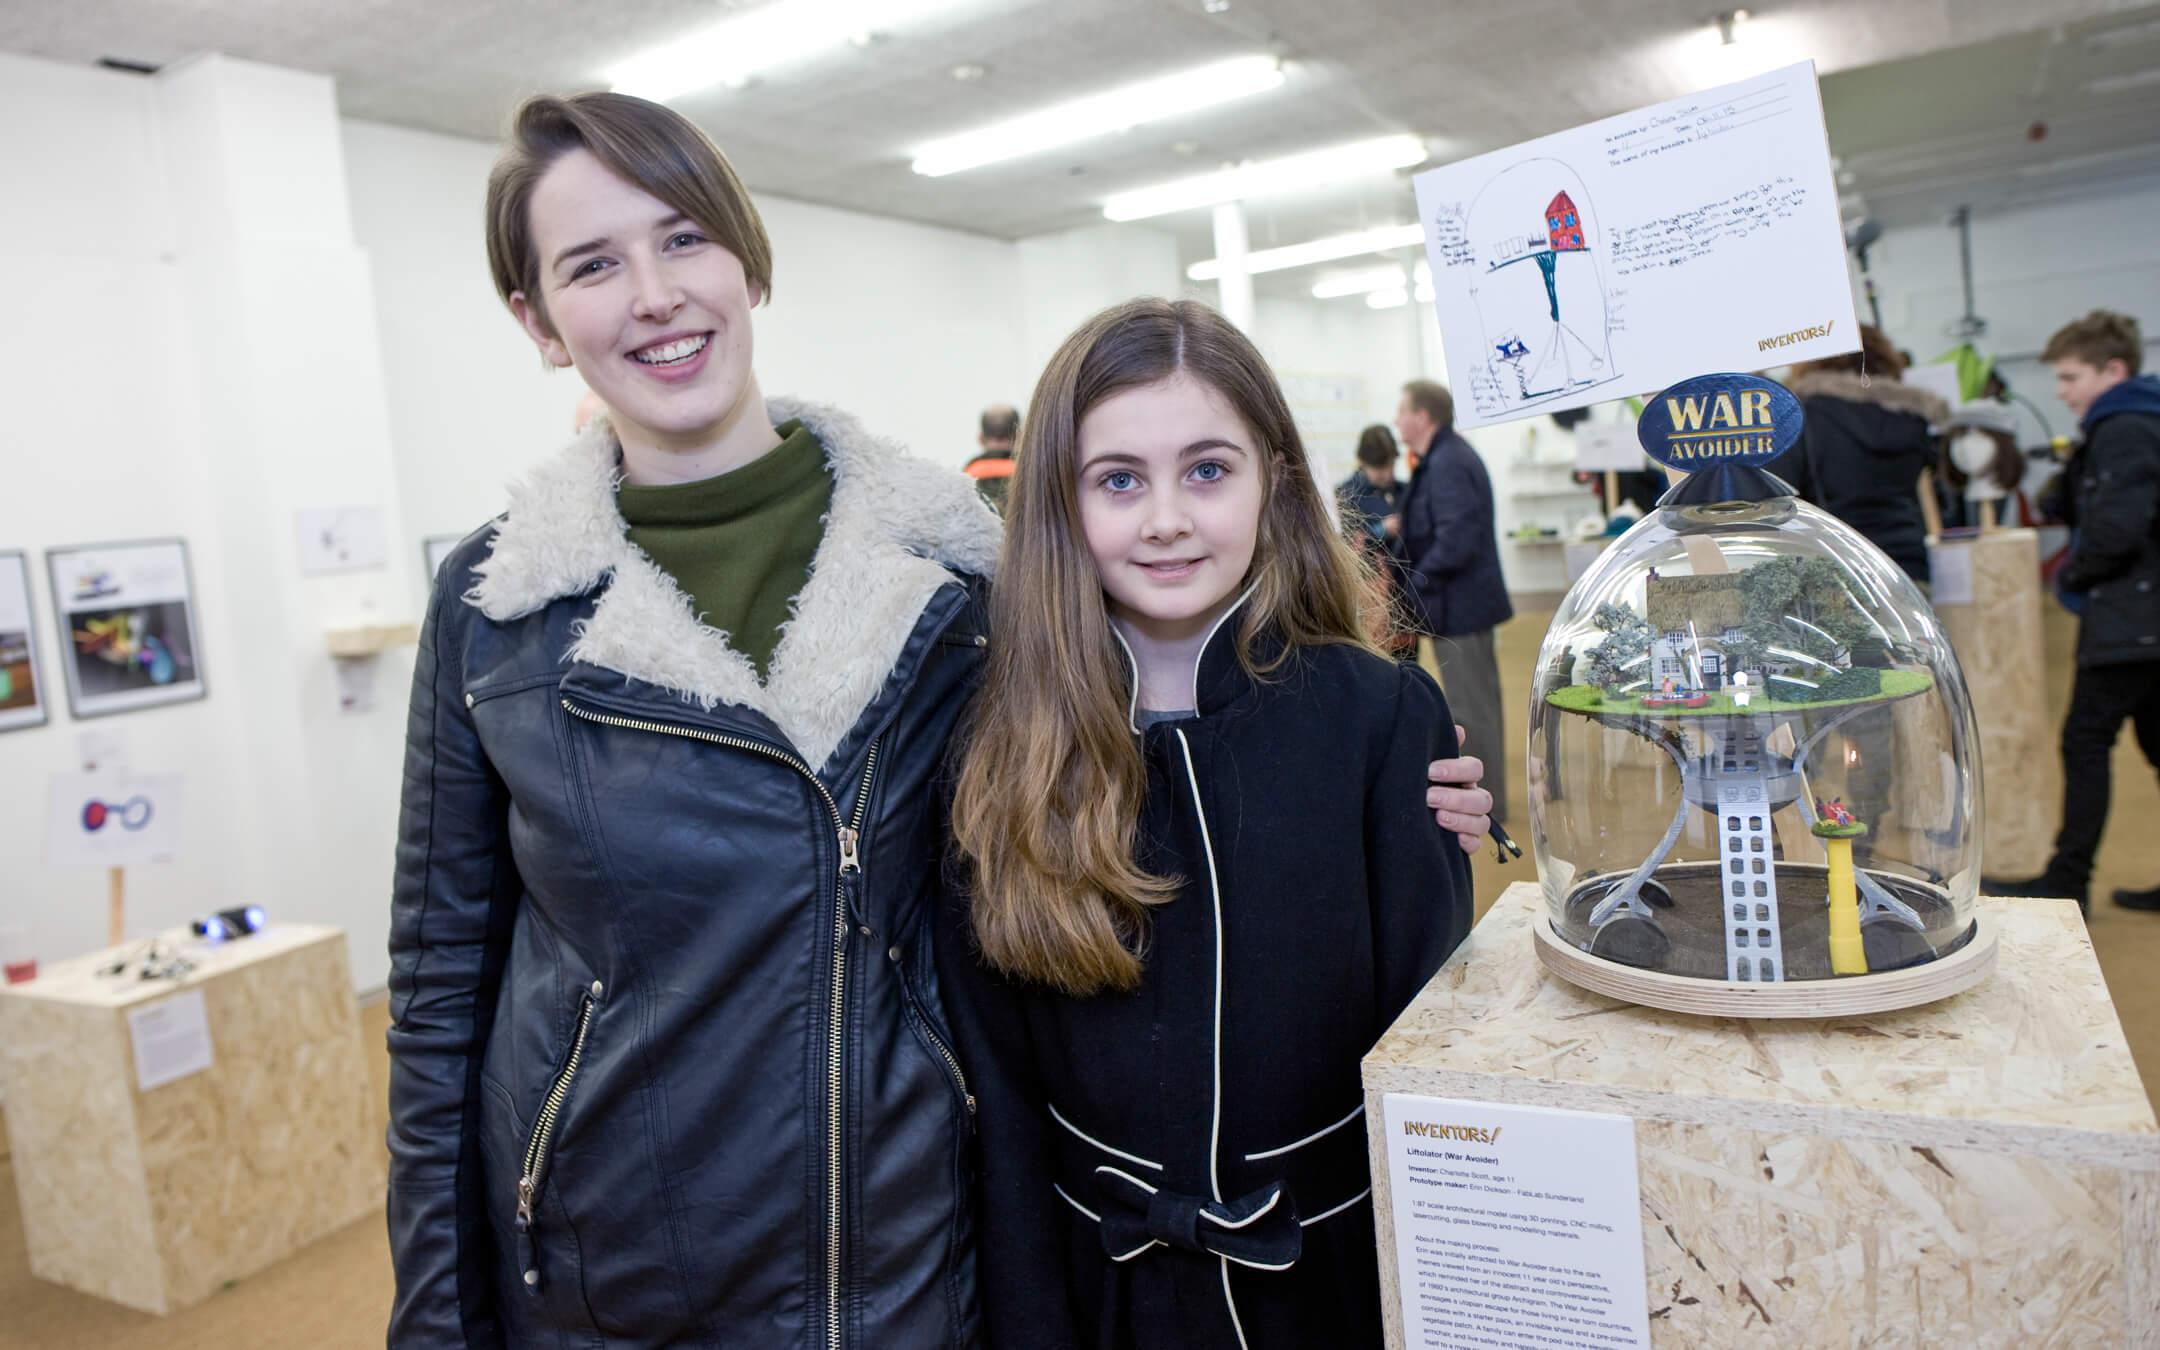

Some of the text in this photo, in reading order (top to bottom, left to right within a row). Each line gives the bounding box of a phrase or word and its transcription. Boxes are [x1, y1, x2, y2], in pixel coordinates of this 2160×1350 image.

[1758, 320, 1834, 351] INVENTORS!
[1665, 388, 1773, 431] WAR
[1670, 436, 1774, 460] AVOIDER
[1404, 1120, 1502, 1145] INVENTORS!
[1407, 1147, 1499, 1166] Liftolator (War Avoider)
[1409, 1164, 1437, 1173] Inventor:
[1493, 1175, 1505, 1183] age
[1410, 1176, 1442, 1186] Prototype
[1444, 1180, 1468, 1189] maker:
[1469, 1183, 1483, 1191] Erin
[1484, 1184, 1511, 1194] Dickson
[1545, 1192, 1584, 1203] Sunderland
[1427, 1201, 1444, 1209] scale
[1445, 1203, 1485, 1215] architectural
[1487, 1209, 1508, 1218] model
[1510, 1213, 1527, 1221] using
[1540, 1216, 1568, 1227] printing,
[1570, 1219, 1586, 1228] CNC
[1453, 1217, 1470, 1226] glass
[1472, 1219, 1497, 1229] blowing
[1513, 1225, 1546, 1236] modelling
[1415, 1234, 1434, 1243] About
[1447, 1239, 1471, 1249] making
[1417, 1258, 1440, 1267] themes
[1442, 1262, 1464, 1271] viewed
[1466, 1265, 1480, 1273] from
[1493, 1269, 1521, 1279] innocent
[1533, 1276, 1547, 1284] year
[1445, 1250, 1466, 1259] initially
[1468, 1253, 1497, 1263] attracted
[1507, 1259, 1520, 1267] War
[1522, 1261, 1547, 1270] Avoider
[1549, 1265, 1562, 1273] due
[1573, 1268, 1584, 1276] the
[1586, 1270, 1600, 1278] dark
[1418, 1270, 1436, 1278] which
[1439, 1272, 1468, 1283] reminded
[1502, 1282, 1529, 1292] abstract
[1546, 1289, 1589, 1301] controversial
[1592, 1296, 1612, 1304] works
[1450, 1286, 1490, 1298] architectural
[1492, 1294, 1511, 1302] group
[1550, 1301, 1563, 1309] The
[1565, 1303, 1578, 1311] War
[1580, 1306, 1605, 1315] Avoider
[1485, 1304, 1508, 1312] escape
[1521, 1308, 1539, 1317] those
[1541, 1312, 1559, 1321] living
[1421, 1305, 1450, 1315] complete
[1474, 1313, 1493, 1321] starter
[1526, 1321, 1552, 1331] invisible
[1554, 1325, 1574, 1334] shield
[1423, 1316, 1453, 1327] vegetable
[1483, 1325, 1501, 1335] family
[1536, 1334, 1547, 1342] the
[1549, 1337, 1562, 1345] pod
[1468, 1334, 1478, 1342] live
[1480, 1336, 1498, 1346] safely
[1501, 1340, 1512, 1348] and
